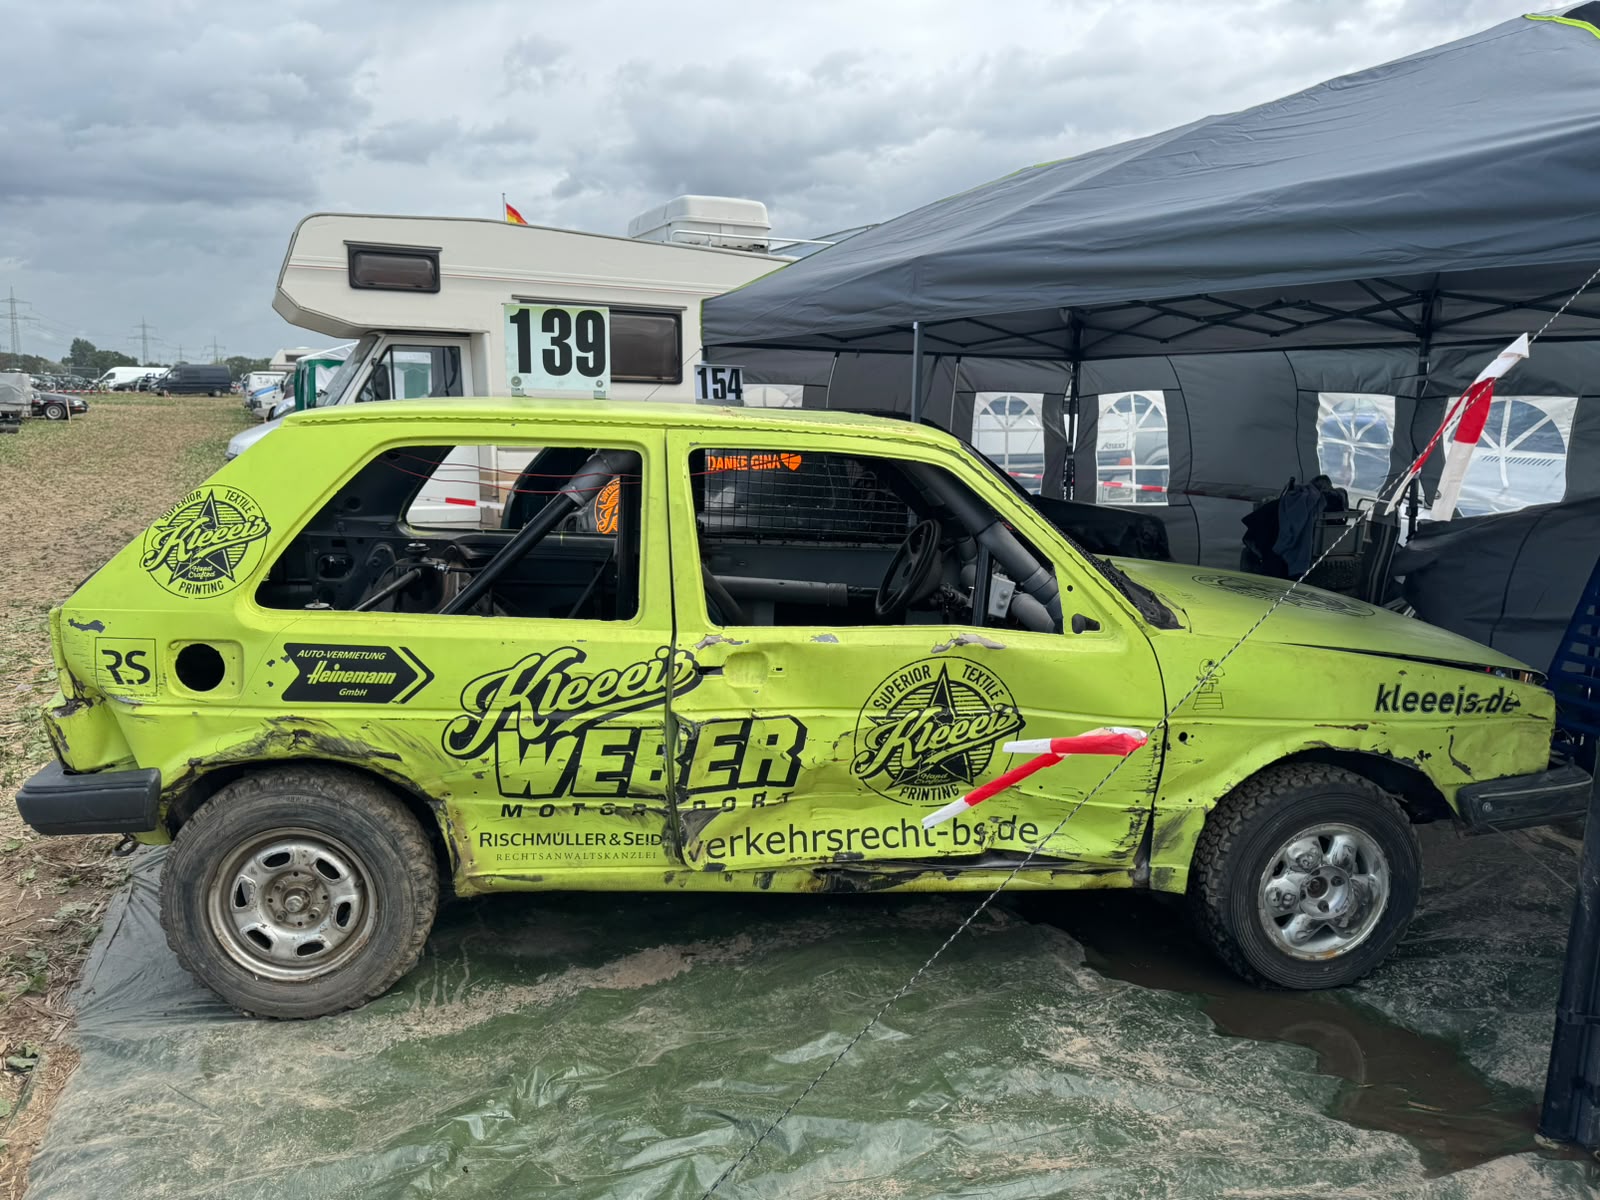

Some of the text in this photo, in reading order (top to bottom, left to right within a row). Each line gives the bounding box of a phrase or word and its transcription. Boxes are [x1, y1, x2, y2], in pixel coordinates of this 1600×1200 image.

[509, 308, 606, 378] 139
[697, 367, 742, 400] 154
[707, 454, 781, 471] DANKE GINA
[160, 490, 202, 521] SUPERIOR
[224, 489, 255, 514] TEXTILE
[178, 580, 224, 595] PRINTING
[101, 649, 151, 685] RS
[296, 649, 386, 660] AUTO-VERMIETUNG
[307, 660, 397, 685] Heinemann
[873, 664, 931, 710] SUPERIOR
[962, 664, 1004, 700] TEXTILE
[338, 688, 368, 697] GmbH
[1375, 683, 1515, 714] kleeeis.de
[495, 714, 808, 799] WEBER
[899, 784, 960, 802] PRINTING
[687, 815, 1039, 862] verkehrsrecht-bs.de
[496, 851, 657, 862] RECHTSANWALTSKANZLEI
